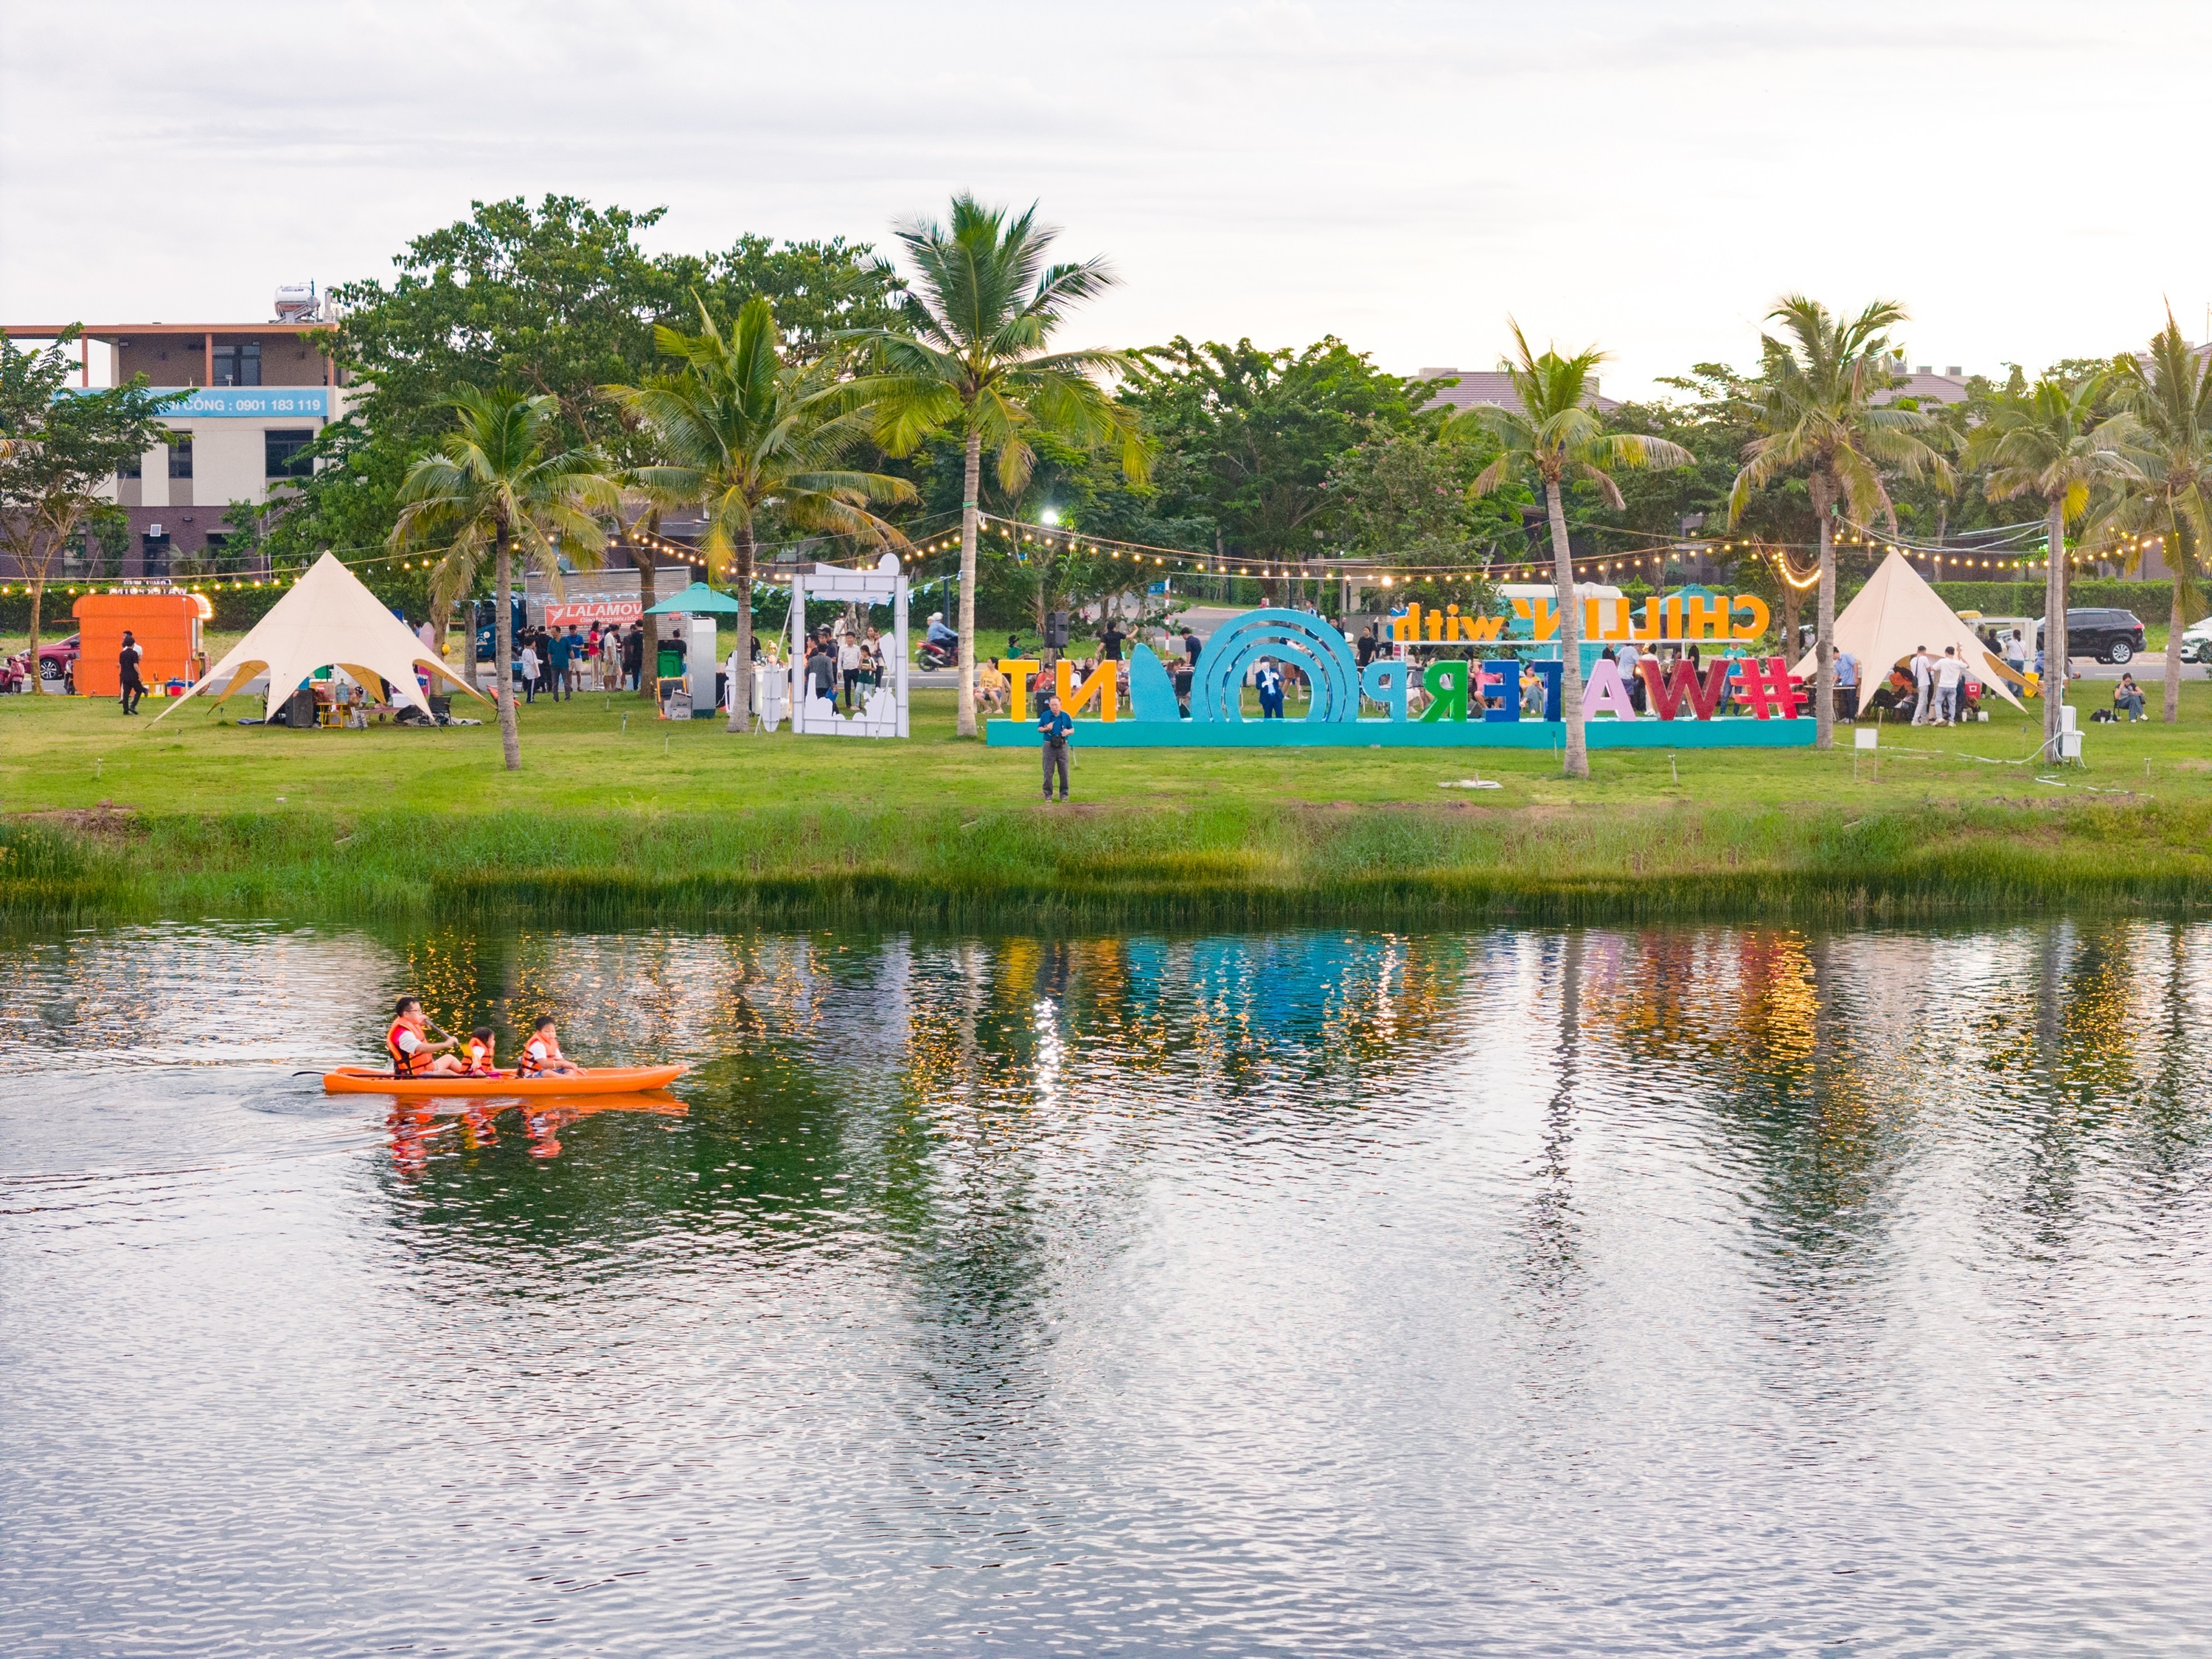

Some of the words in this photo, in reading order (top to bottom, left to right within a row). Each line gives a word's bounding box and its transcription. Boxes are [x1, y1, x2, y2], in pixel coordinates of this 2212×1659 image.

[183, 397, 225, 411] CÔNG
[236, 400, 265, 411] 0901
[271, 400, 293, 410] 183
[297, 400, 321, 410] 119
